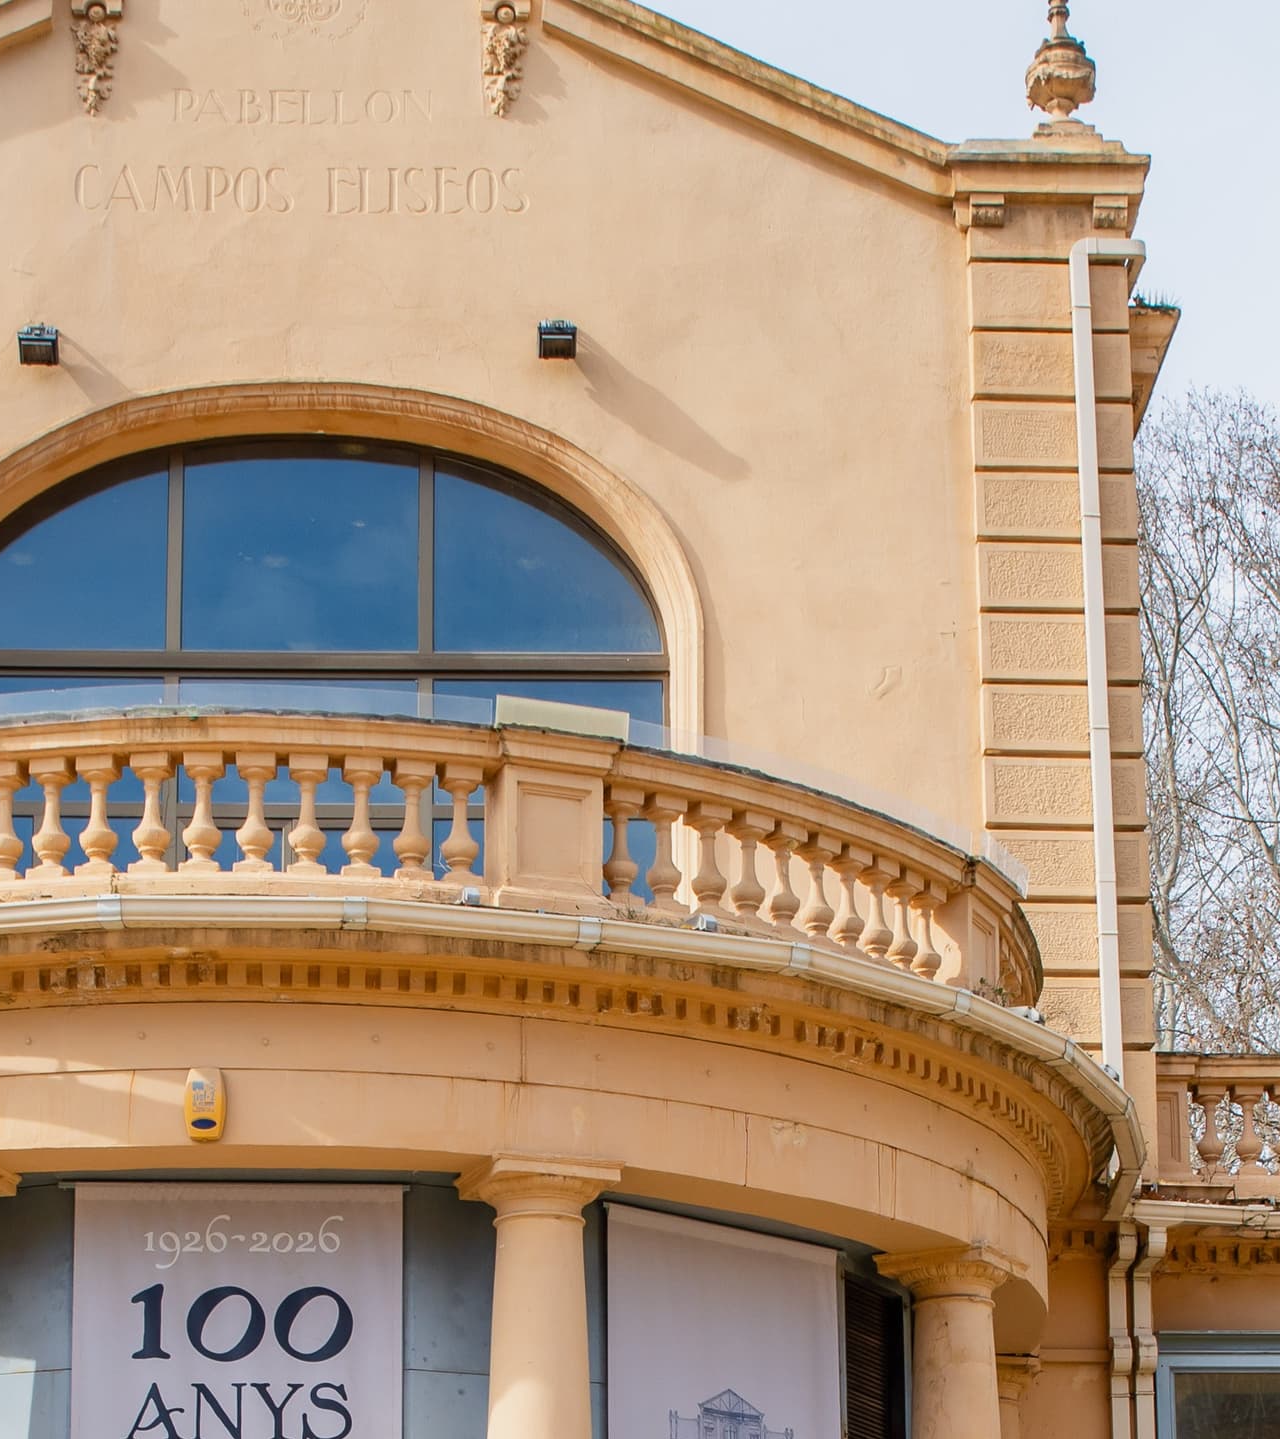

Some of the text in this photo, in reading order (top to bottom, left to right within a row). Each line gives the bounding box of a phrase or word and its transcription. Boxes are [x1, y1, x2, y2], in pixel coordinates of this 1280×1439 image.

[171, 87, 434, 127] PABELLON
[73, 163, 531, 216] CAMPOS ELISEOS
[143, 1214, 345, 1270] 1926-2026
[130, 1283, 354, 1362] 100
